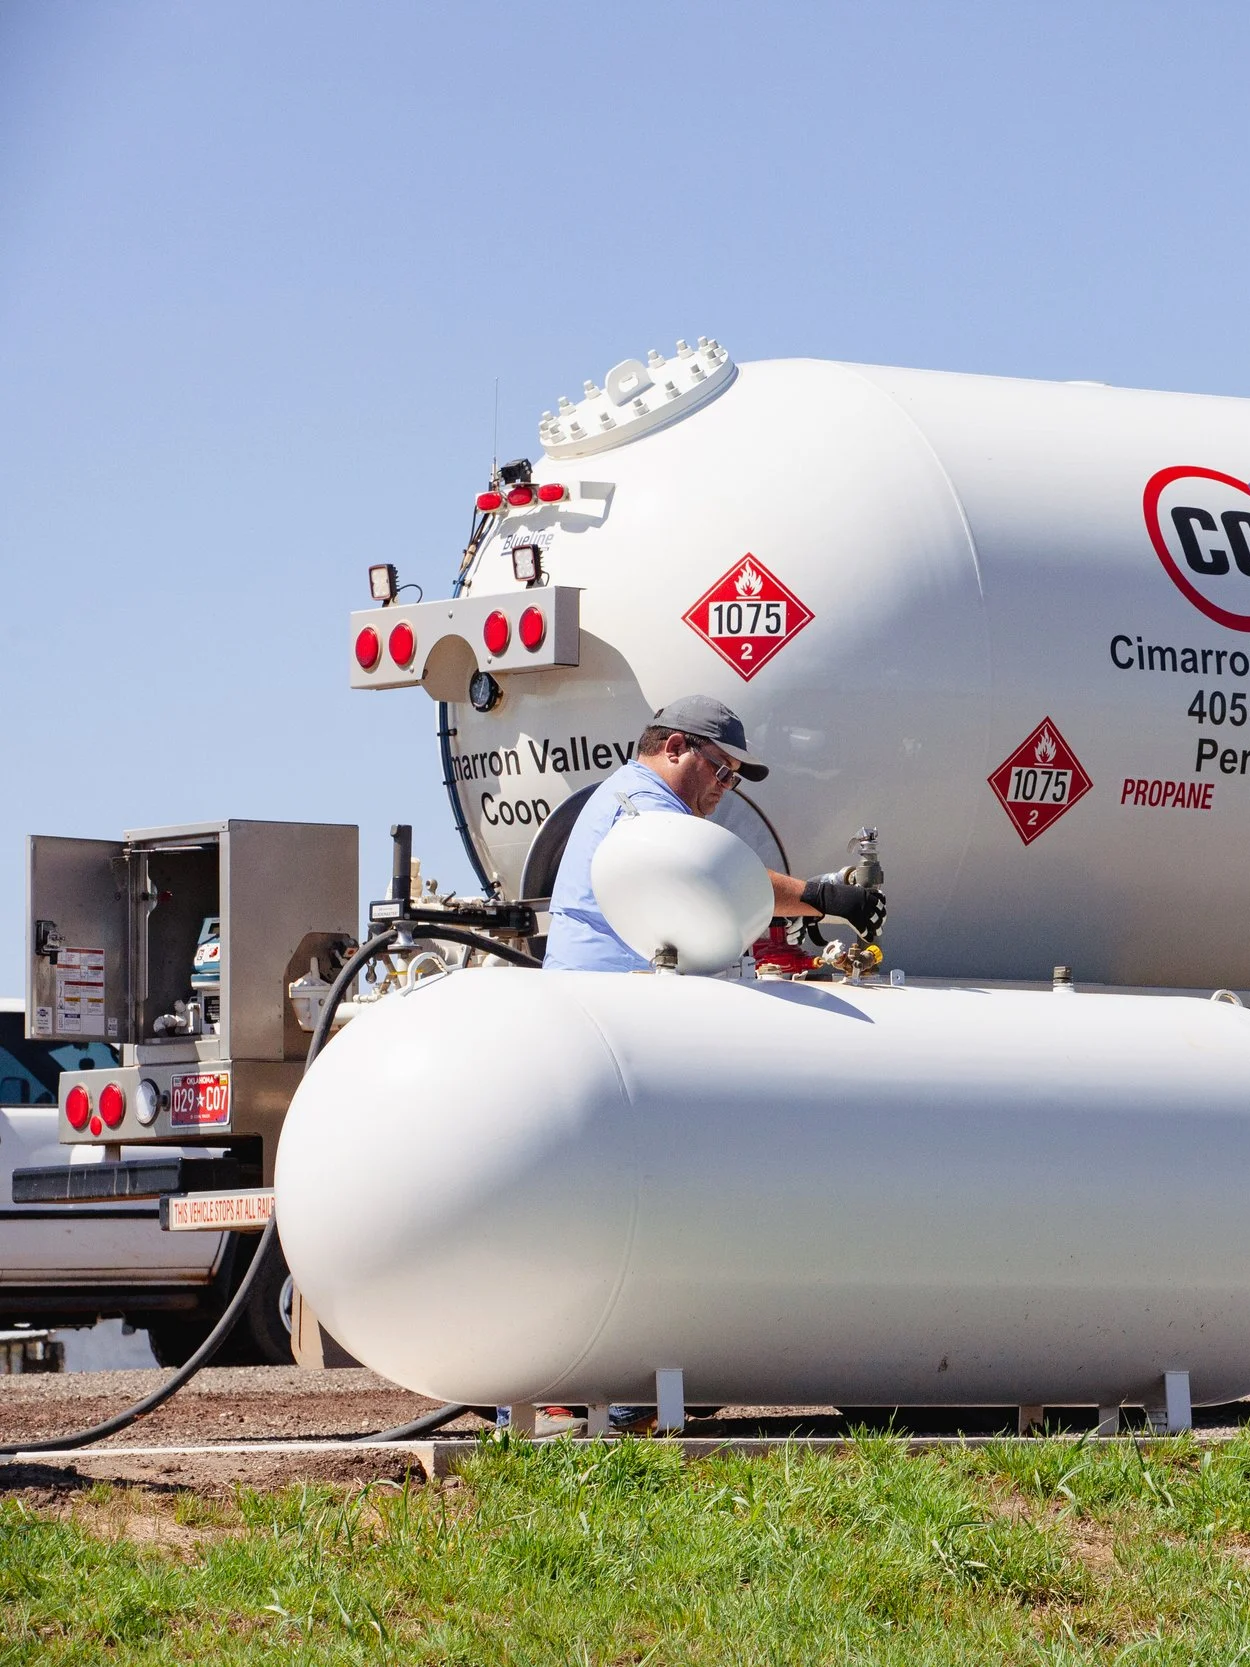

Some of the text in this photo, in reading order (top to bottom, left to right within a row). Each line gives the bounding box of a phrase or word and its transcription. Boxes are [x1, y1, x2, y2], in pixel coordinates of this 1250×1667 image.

[713, 603, 781, 635] 1075
[740, 643, 753, 660] 2
[451, 736, 635, 781] marron Valley
[1013, 769, 1068, 803] 1075
[1120, 778, 1215, 809] PROPANE
[481, 791, 550, 826] Coop
[1027, 809, 1039, 826] 2
[174, 1088, 195, 1112] 029
[174, 1203, 188, 1224] THIS
[190, 1201, 214, 1223] VEHICLE
[214, 1200, 234, 1221] STOPS
[236, 1199, 243, 1219] AT
[245, 1198, 256, 1219] ALL
